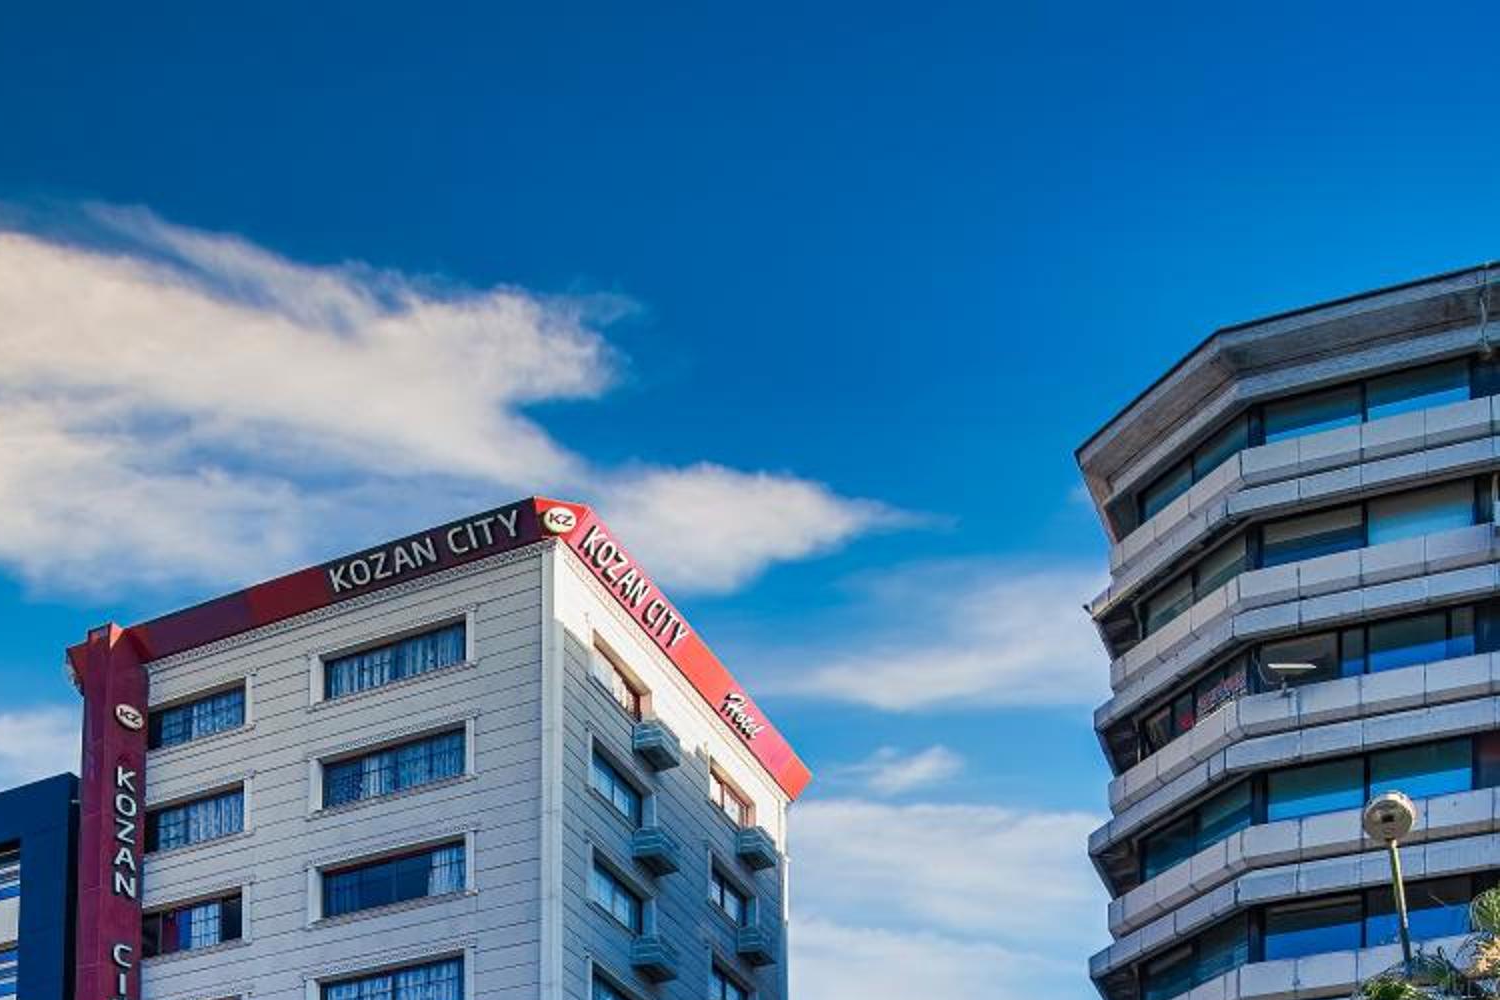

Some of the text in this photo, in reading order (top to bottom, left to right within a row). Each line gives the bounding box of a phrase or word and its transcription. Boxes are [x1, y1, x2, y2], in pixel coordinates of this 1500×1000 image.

[329, 509, 519, 593] KOZAN CITY
[580, 525, 689, 648] KOZAN CITY
[721, 691, 765, 740] Hotel
[114, 765, 137, 899] KOZAN
